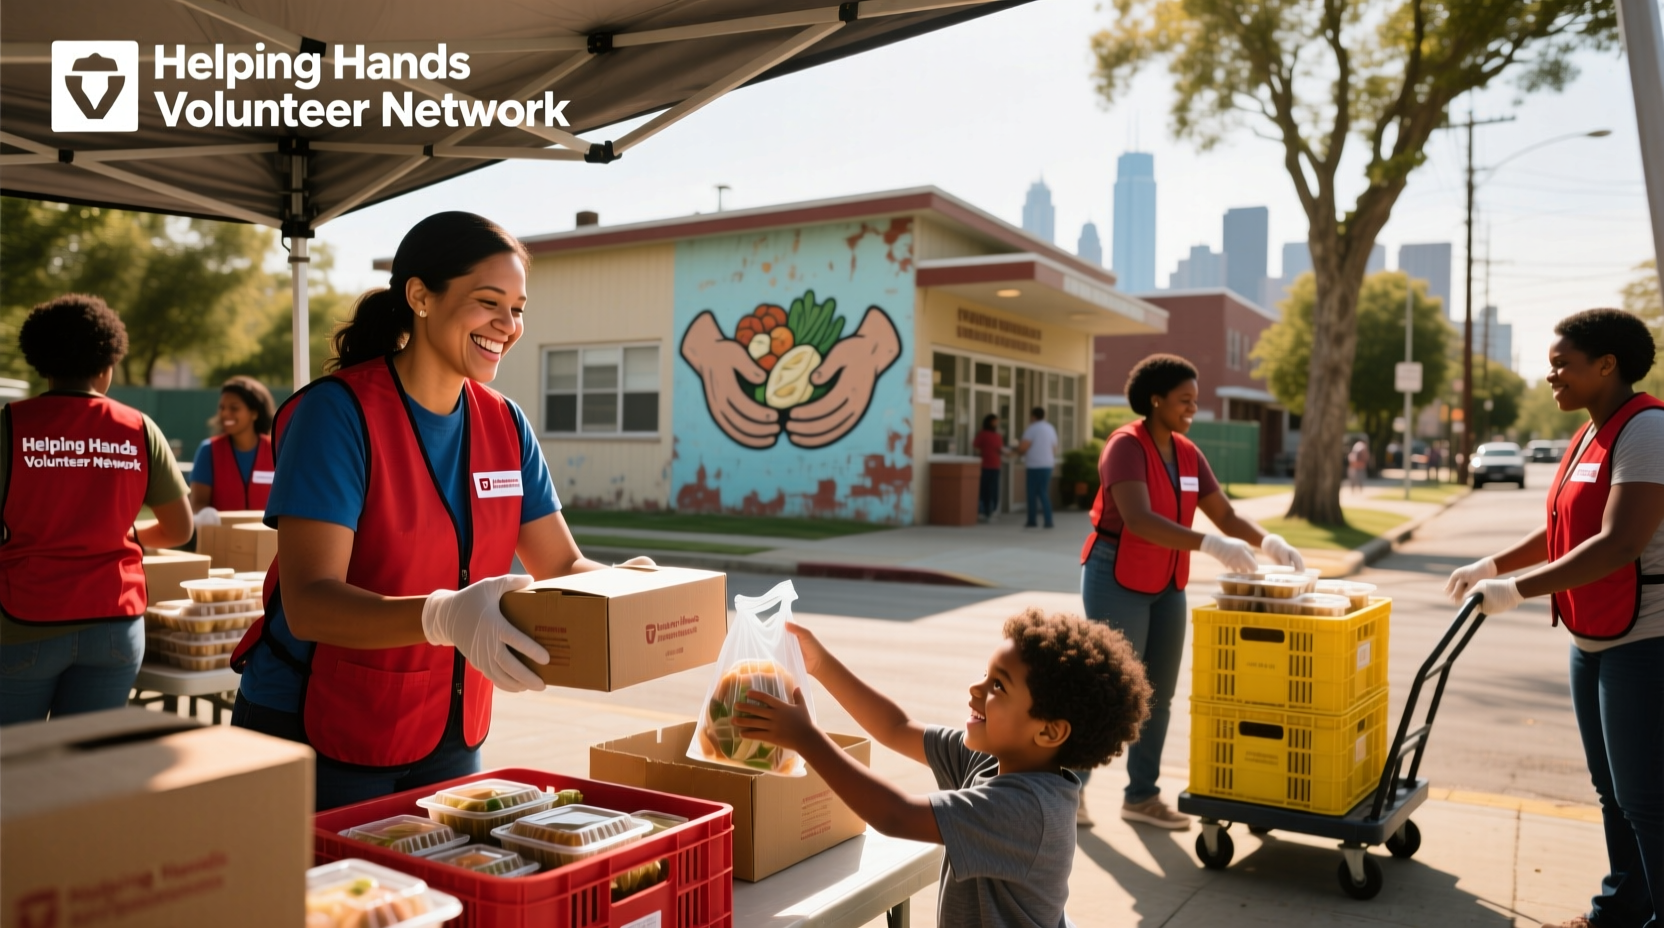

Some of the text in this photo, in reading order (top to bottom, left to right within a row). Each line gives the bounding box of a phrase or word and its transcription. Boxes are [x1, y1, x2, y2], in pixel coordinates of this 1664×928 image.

[22, 437, 139, 456] Helping Hands
[24, 454, 91, 468] Volunteer
